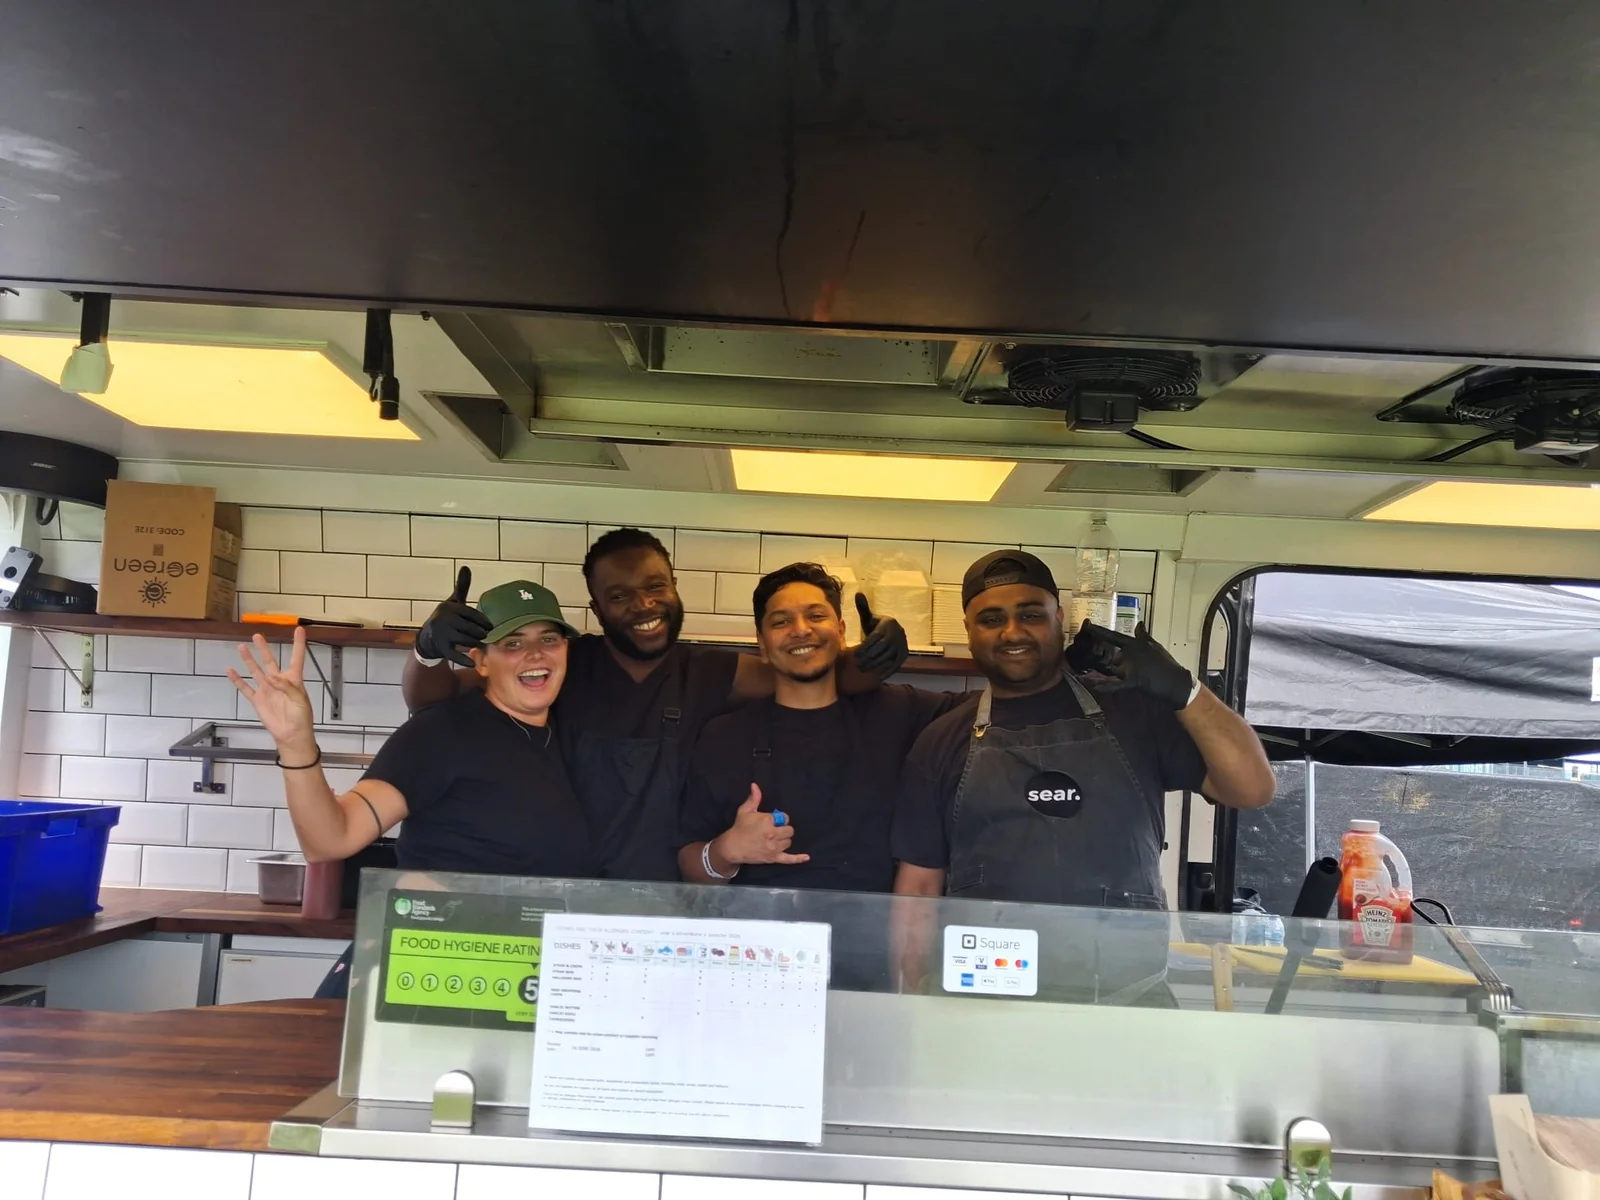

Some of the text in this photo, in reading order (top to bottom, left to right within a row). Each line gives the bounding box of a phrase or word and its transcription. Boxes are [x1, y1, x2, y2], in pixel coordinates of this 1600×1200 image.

[134, 525, 186, 536] CODE: 312E
[114, 558, 199, 578] eGreen
[1028, 788, 1081, 802] sear.
[1366, 909, 1388, 918] HEINZ
[400, 936, 541, 957] FOOD HYGIENE RATIN
[554, 942, 582, 950] DISHES
[980, 937, 1021, 951] Square
[524, 979, 539, 1001] 5
